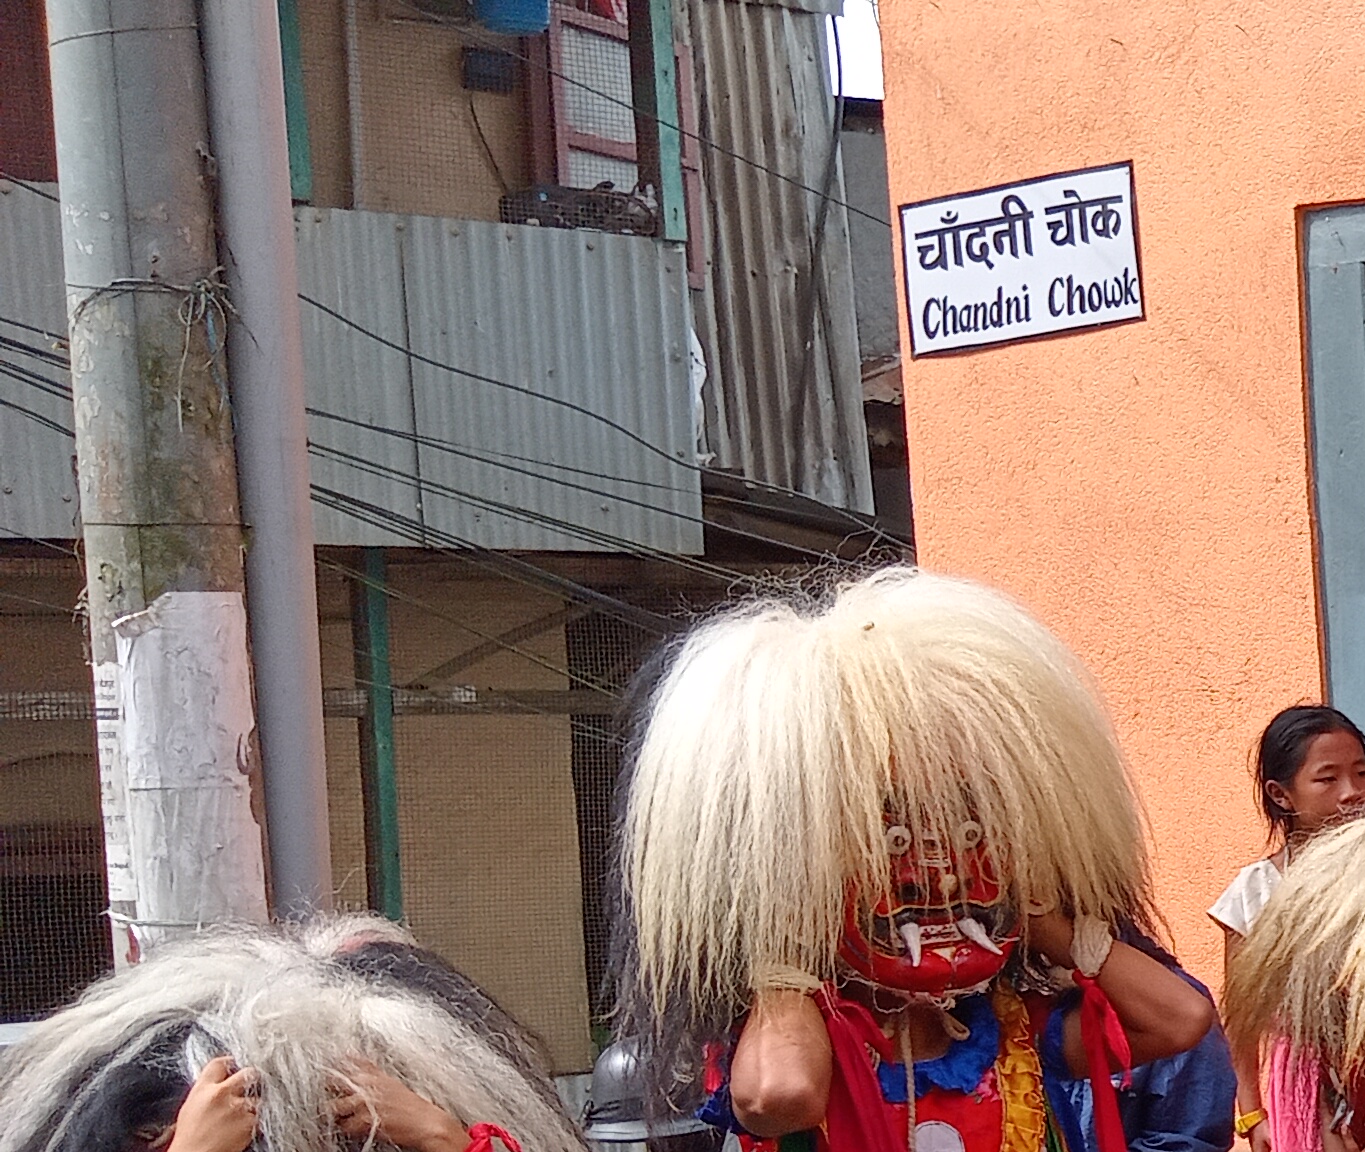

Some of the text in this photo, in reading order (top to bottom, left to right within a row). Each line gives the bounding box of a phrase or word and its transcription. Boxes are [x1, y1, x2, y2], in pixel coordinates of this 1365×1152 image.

[915, 189, 1123, 270] चाँदनी चोक
[922, 267, 1139, 340] Chandni Chowk
